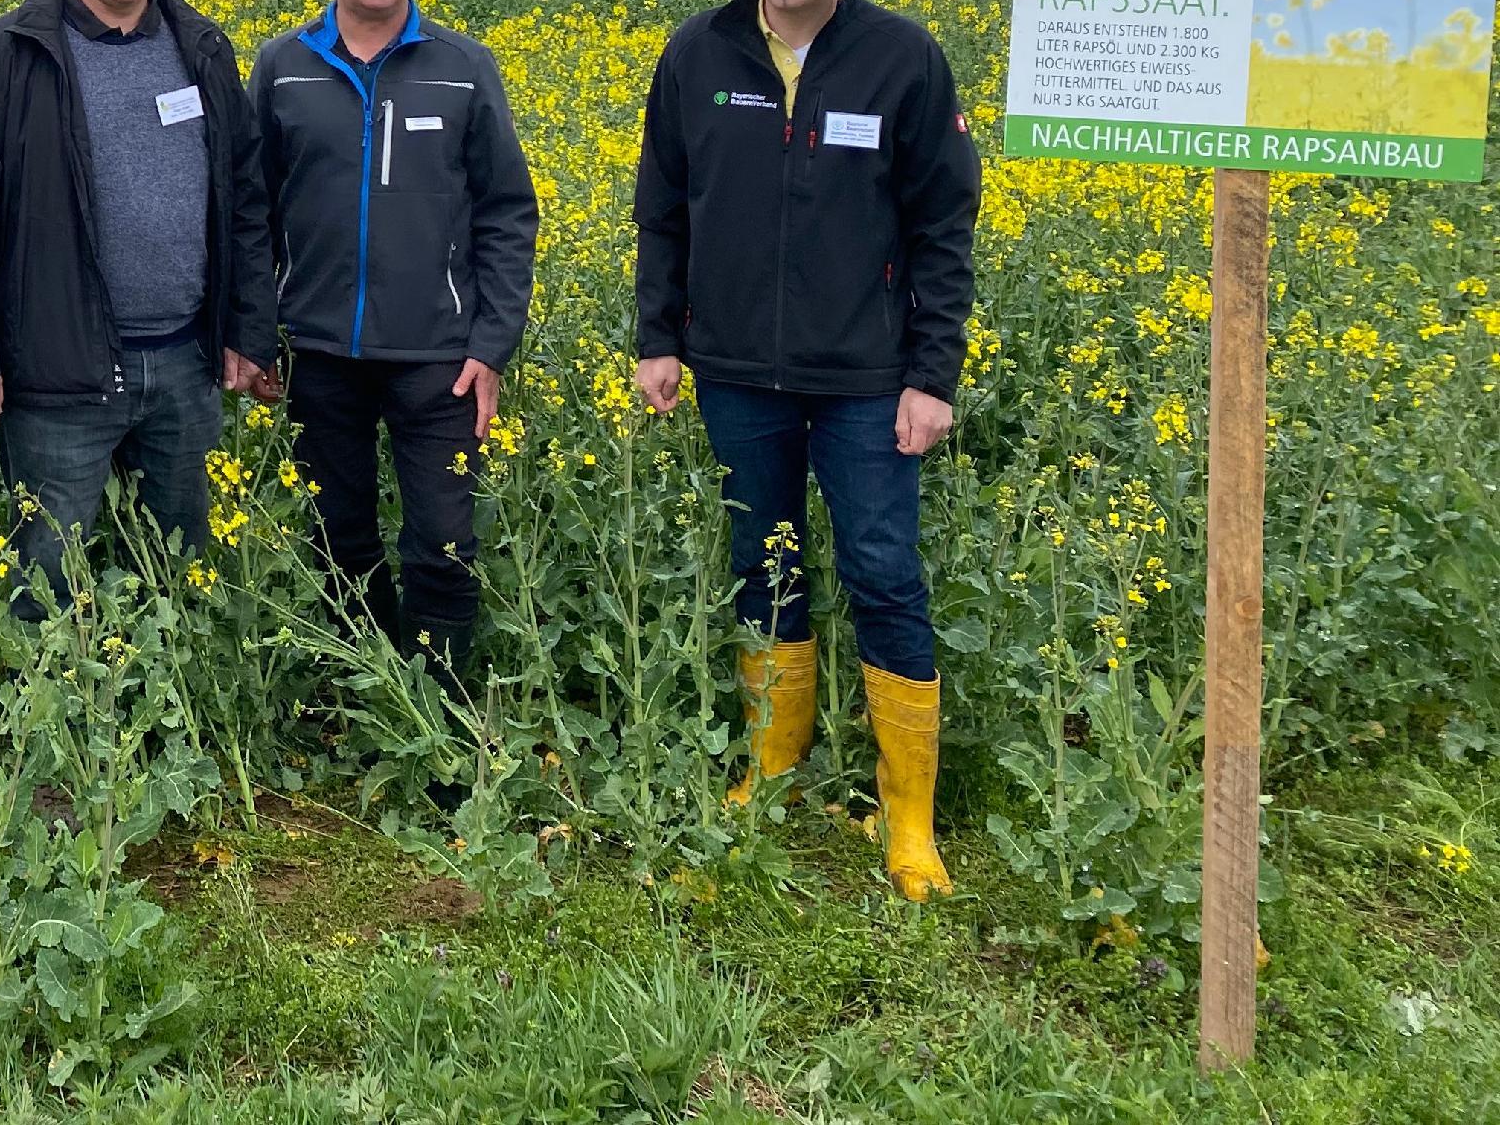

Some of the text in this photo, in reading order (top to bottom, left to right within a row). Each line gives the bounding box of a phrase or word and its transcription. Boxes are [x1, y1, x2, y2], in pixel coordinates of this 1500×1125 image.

[1038, 21, 1208, 40] DARAUS ENTSTEHEN 1.800
[1037, 39, 1220, 59] LITER RAPSÖL UND 2.300 KG
[1036, 57, 1196, 75] HOCHWERTIGES EIWEISS-
[1133, 79, 1161, 93] UND
[1167, 81, 1192, 94] DAS
[1196, 83, 1221, 95] AUS
[1034, 93, 1160, 110] NUR 3 KG SAATGUT.
[1031, 123, 1444, 170] NACHHALTIGER RAPSANBAU
